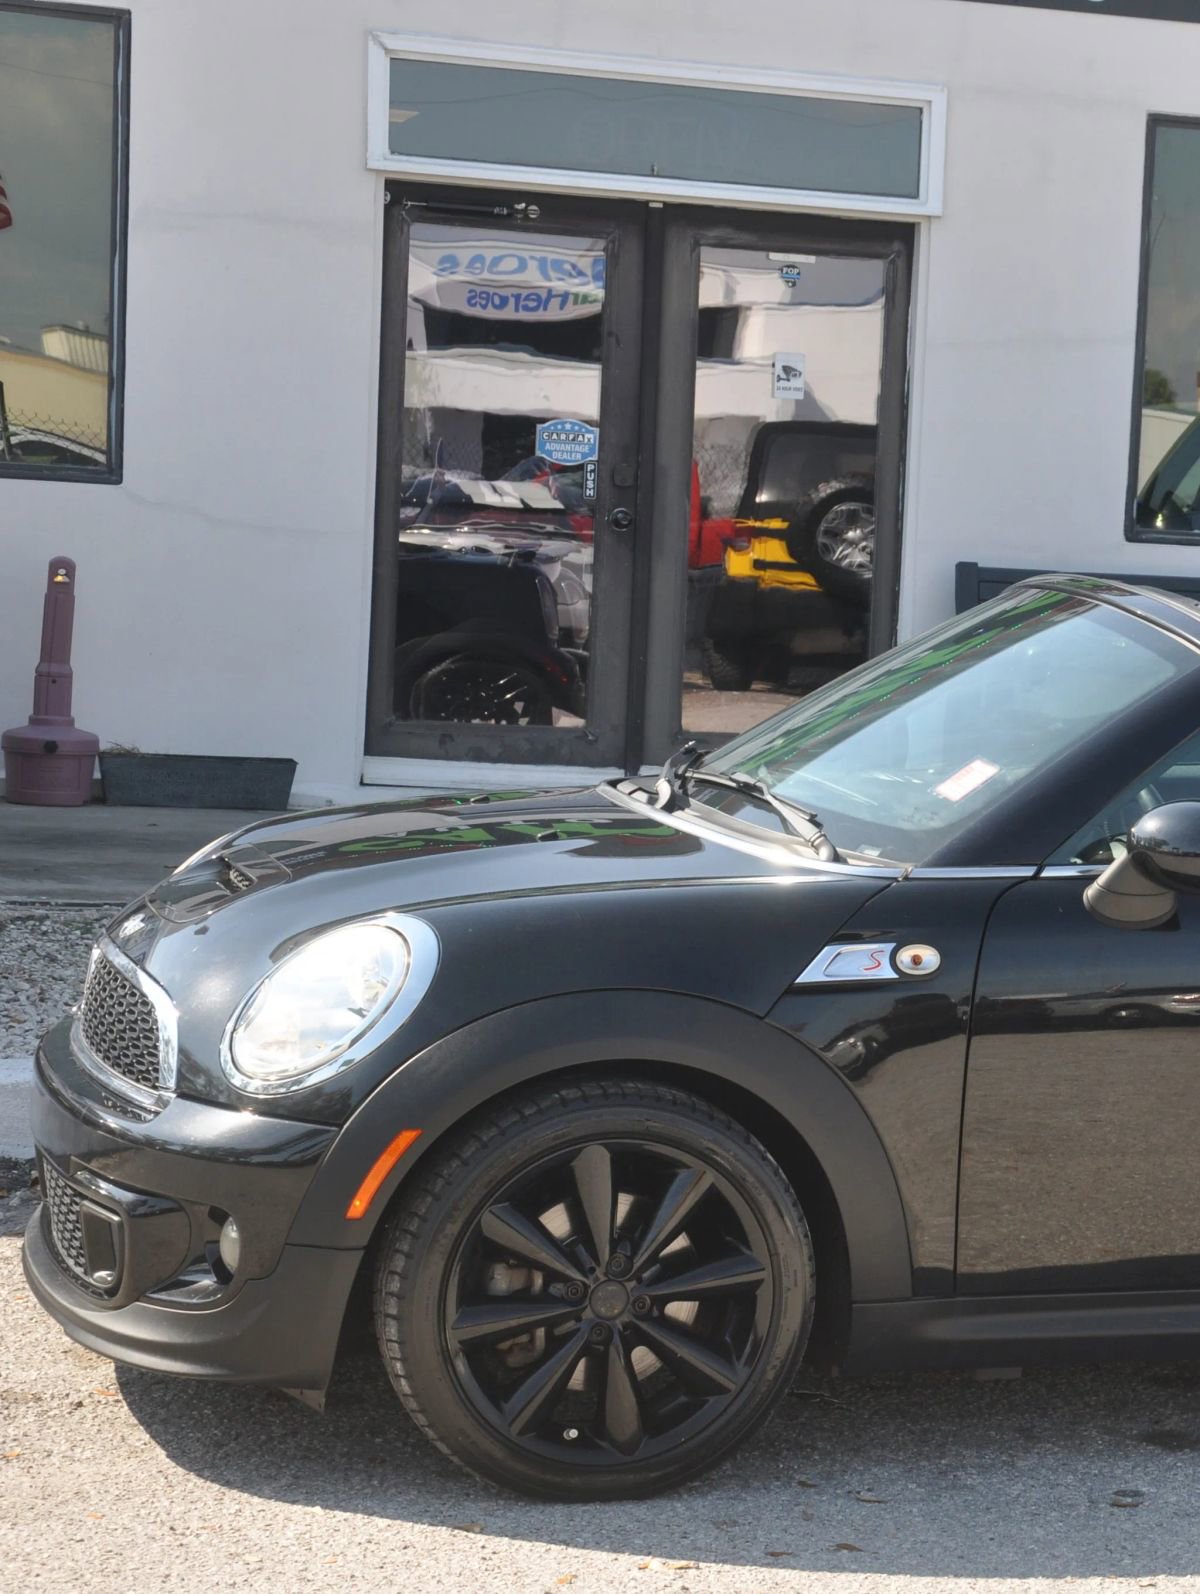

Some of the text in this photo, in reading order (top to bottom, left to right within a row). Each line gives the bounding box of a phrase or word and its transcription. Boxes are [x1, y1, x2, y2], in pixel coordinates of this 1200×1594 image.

[542, 432, 594, 444] CARFAX
[545, 442, 590, 453] ADVANTAGE
[552, 451, 582, 460] DEALER
[586, 464, 595, 497] PUSH
[863, 950, 885, 971] S
